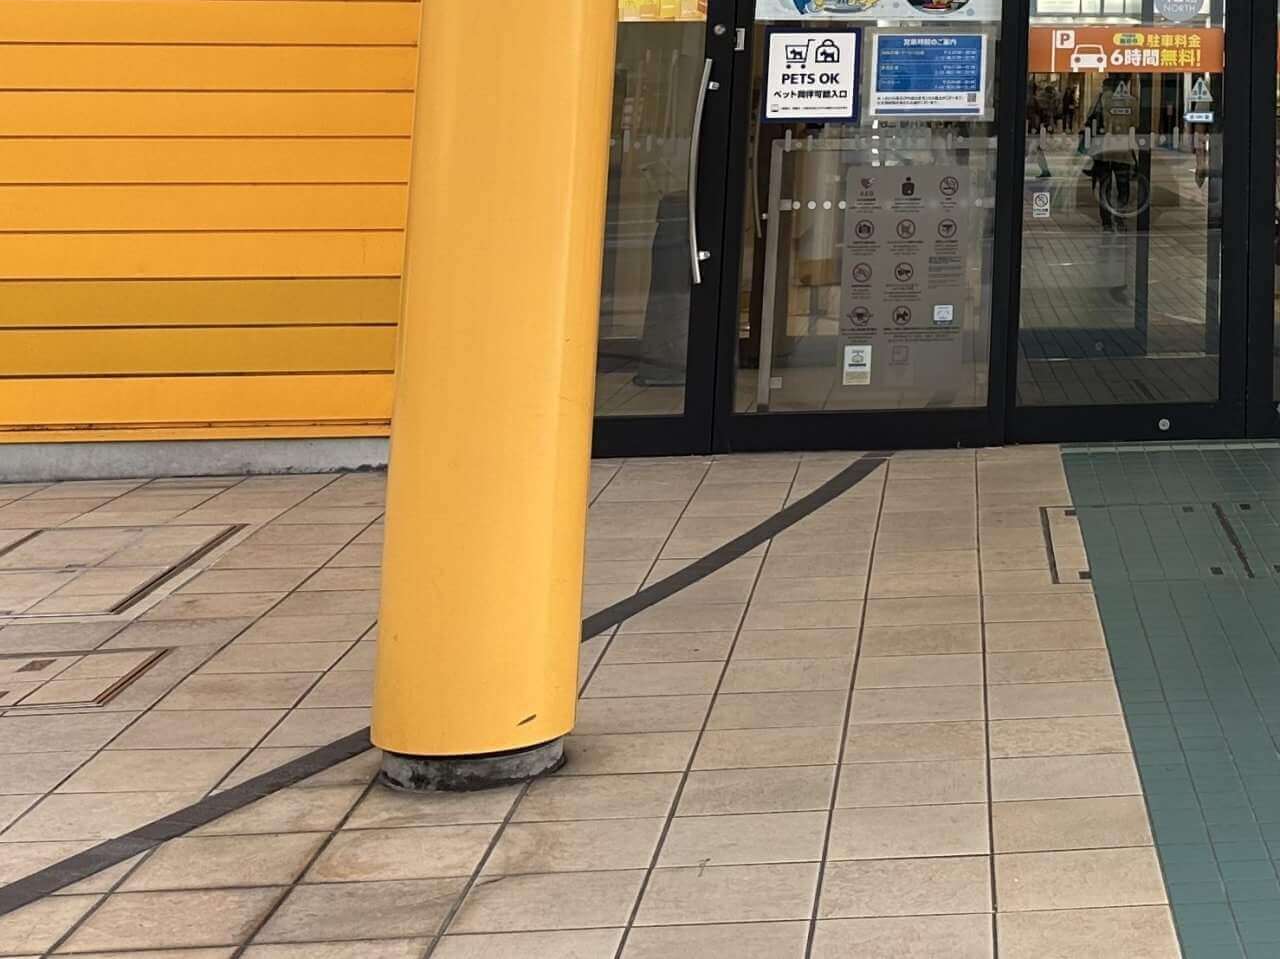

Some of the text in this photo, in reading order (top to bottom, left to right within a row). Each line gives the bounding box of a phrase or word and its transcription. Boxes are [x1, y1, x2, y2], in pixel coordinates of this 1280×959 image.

[1147, 33, 1201, 48] 駐車料金
[781, 73, 840, 85] PETS OK
